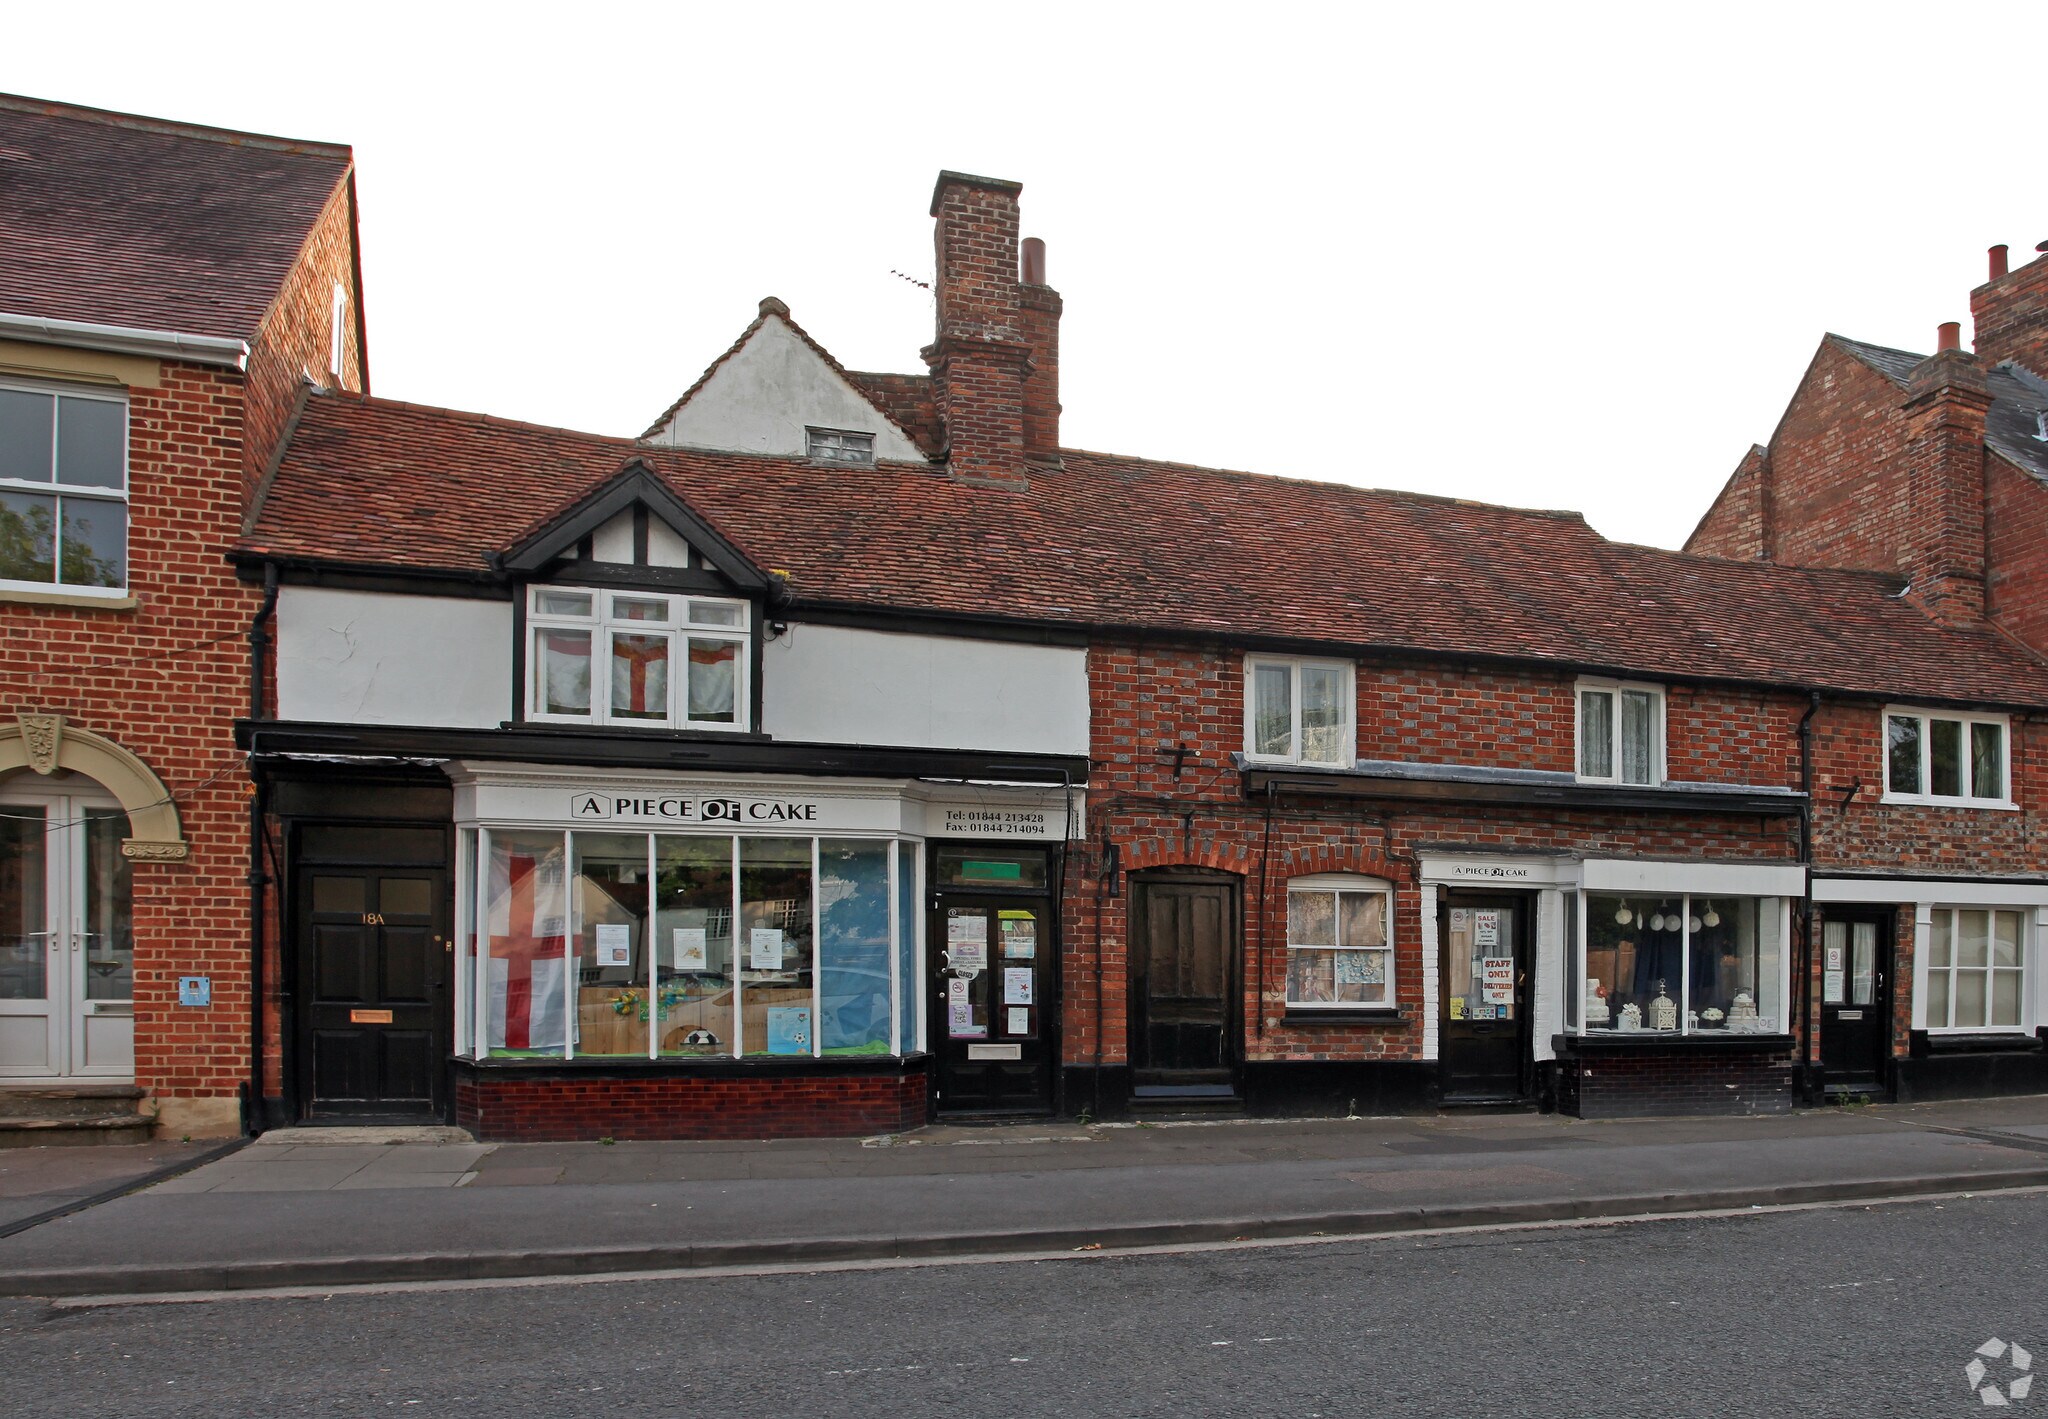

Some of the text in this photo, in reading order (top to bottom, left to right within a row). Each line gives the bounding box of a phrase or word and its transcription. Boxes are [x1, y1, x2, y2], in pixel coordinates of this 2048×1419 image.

[582, 797, 817, 821] A PIECE OF CAKE
[946, 810, 1044, 823] Tel: 01844 213428
[946, 822, 1045, 834] Fax: 01844 214094
[1465, 867, 1489, 875] PIECE
[1491, 868, 1504, 876] OF
[1505, 869, 1528, 877] CAKE
[362, 912, 385, 925] 18A
[1485, 960, 1511, 968] STAFF
[957, 969, 974, 979] CLOSED
[1488, 970, 1511, 978] ONLY
